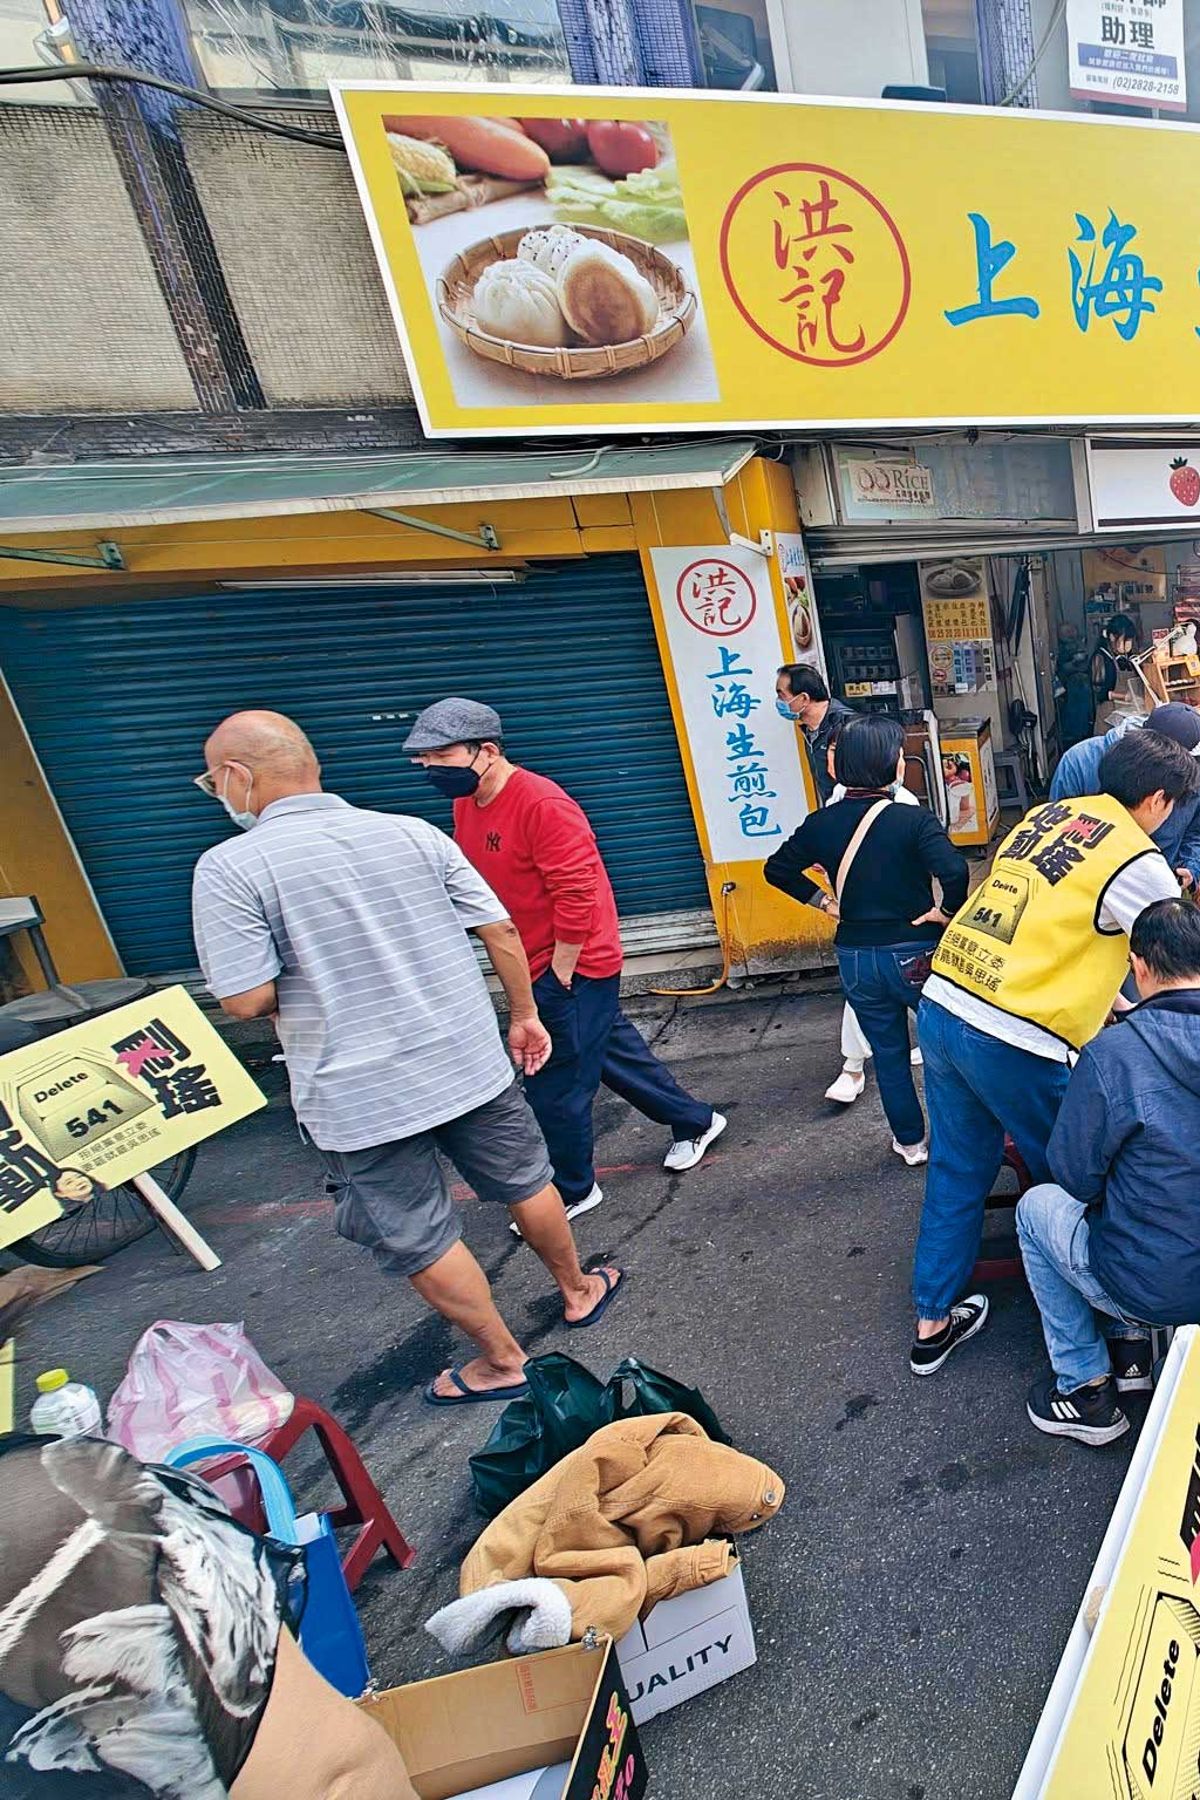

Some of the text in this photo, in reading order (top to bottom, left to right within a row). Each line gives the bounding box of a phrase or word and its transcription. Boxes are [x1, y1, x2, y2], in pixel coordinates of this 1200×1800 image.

[1101, 16, 1155, 50] 助理
[772, 176, 867, 356] 洪記
[692, 567, 742, 627] 洪記
[705, 646, 782, 837] 上海生煎包
[1000, 801, 1073, 862] 地動
[971, 905, 1004, 929] 541
[33, 1070, 89, 1104] Delete
[65, 1098, 124, 1139] 541
[628, 1633, 733, 1704] UALITY
[1142, 1638, 1181, 1787] Delete
